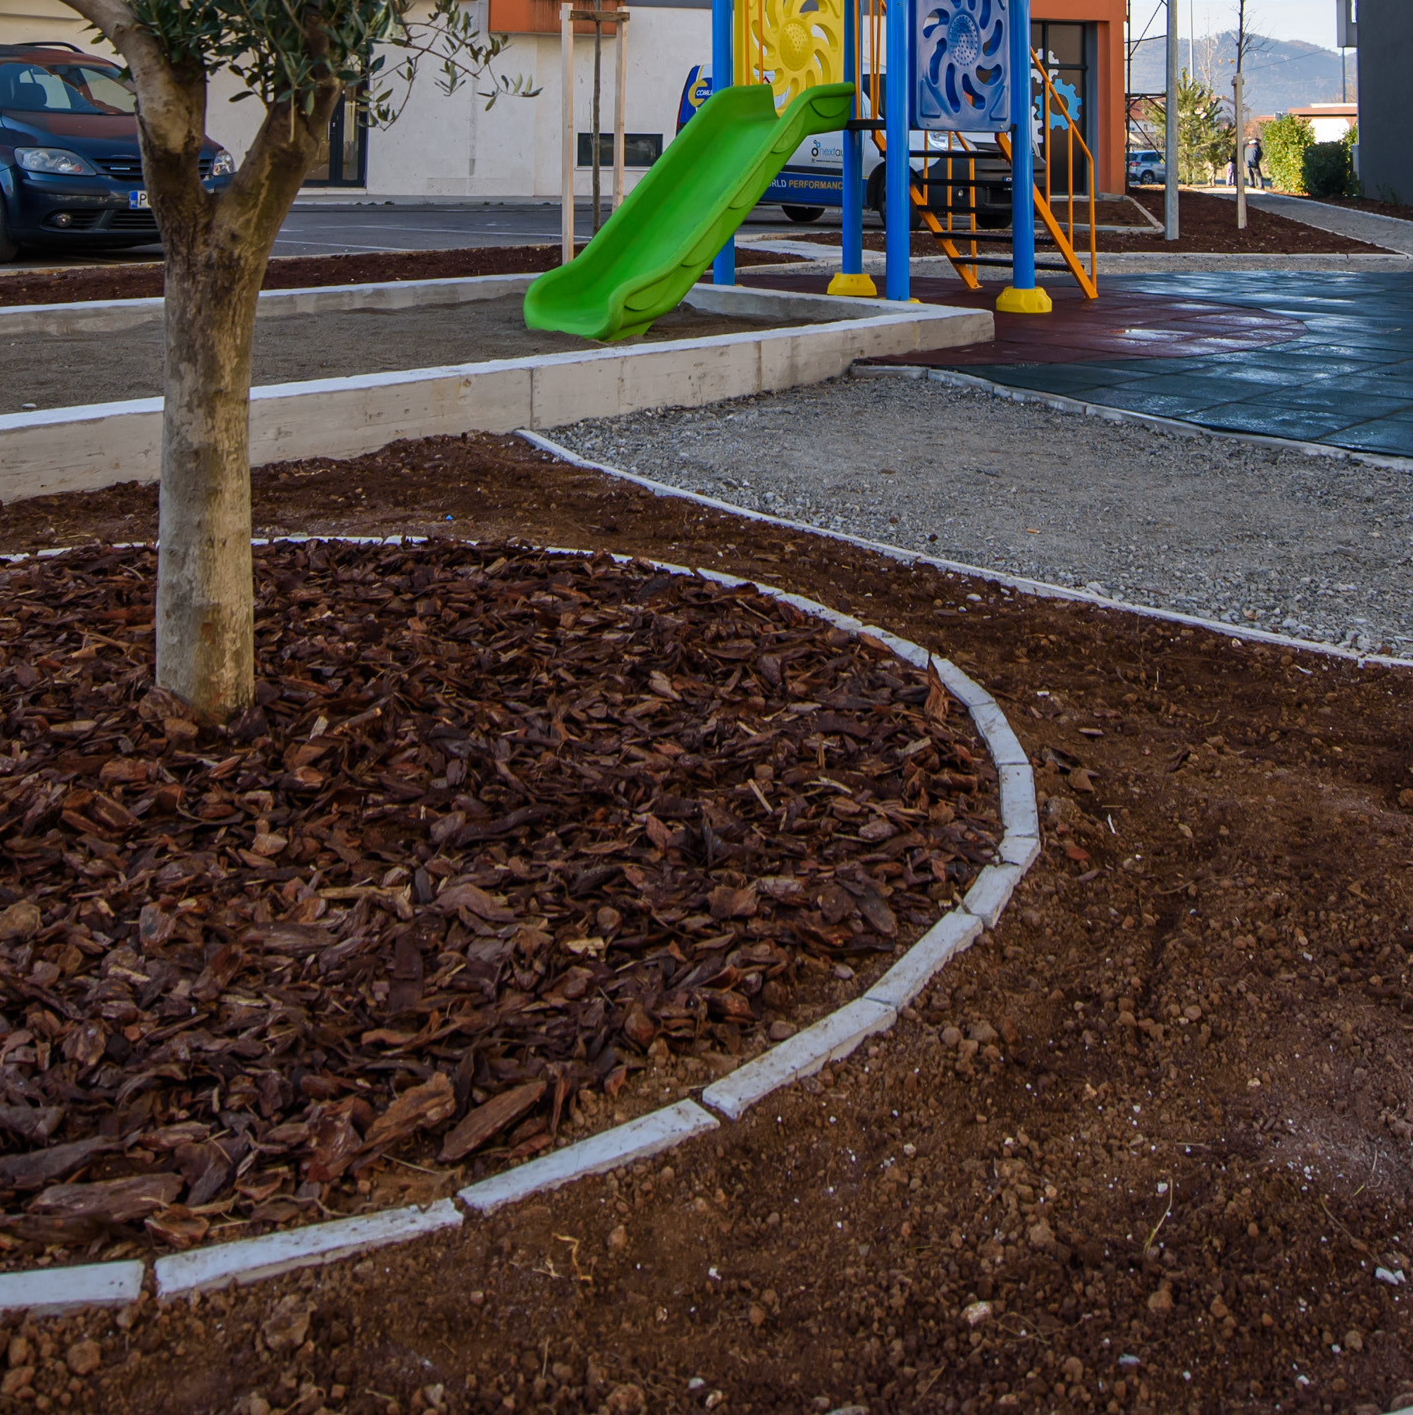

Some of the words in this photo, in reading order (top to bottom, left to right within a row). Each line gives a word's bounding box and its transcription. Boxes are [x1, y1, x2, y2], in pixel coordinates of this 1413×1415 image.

[819, 147, 843, 157] nextau
[768, 179, 787, 188] RLD
[788, 179, 843, 190] PERFORMANC
